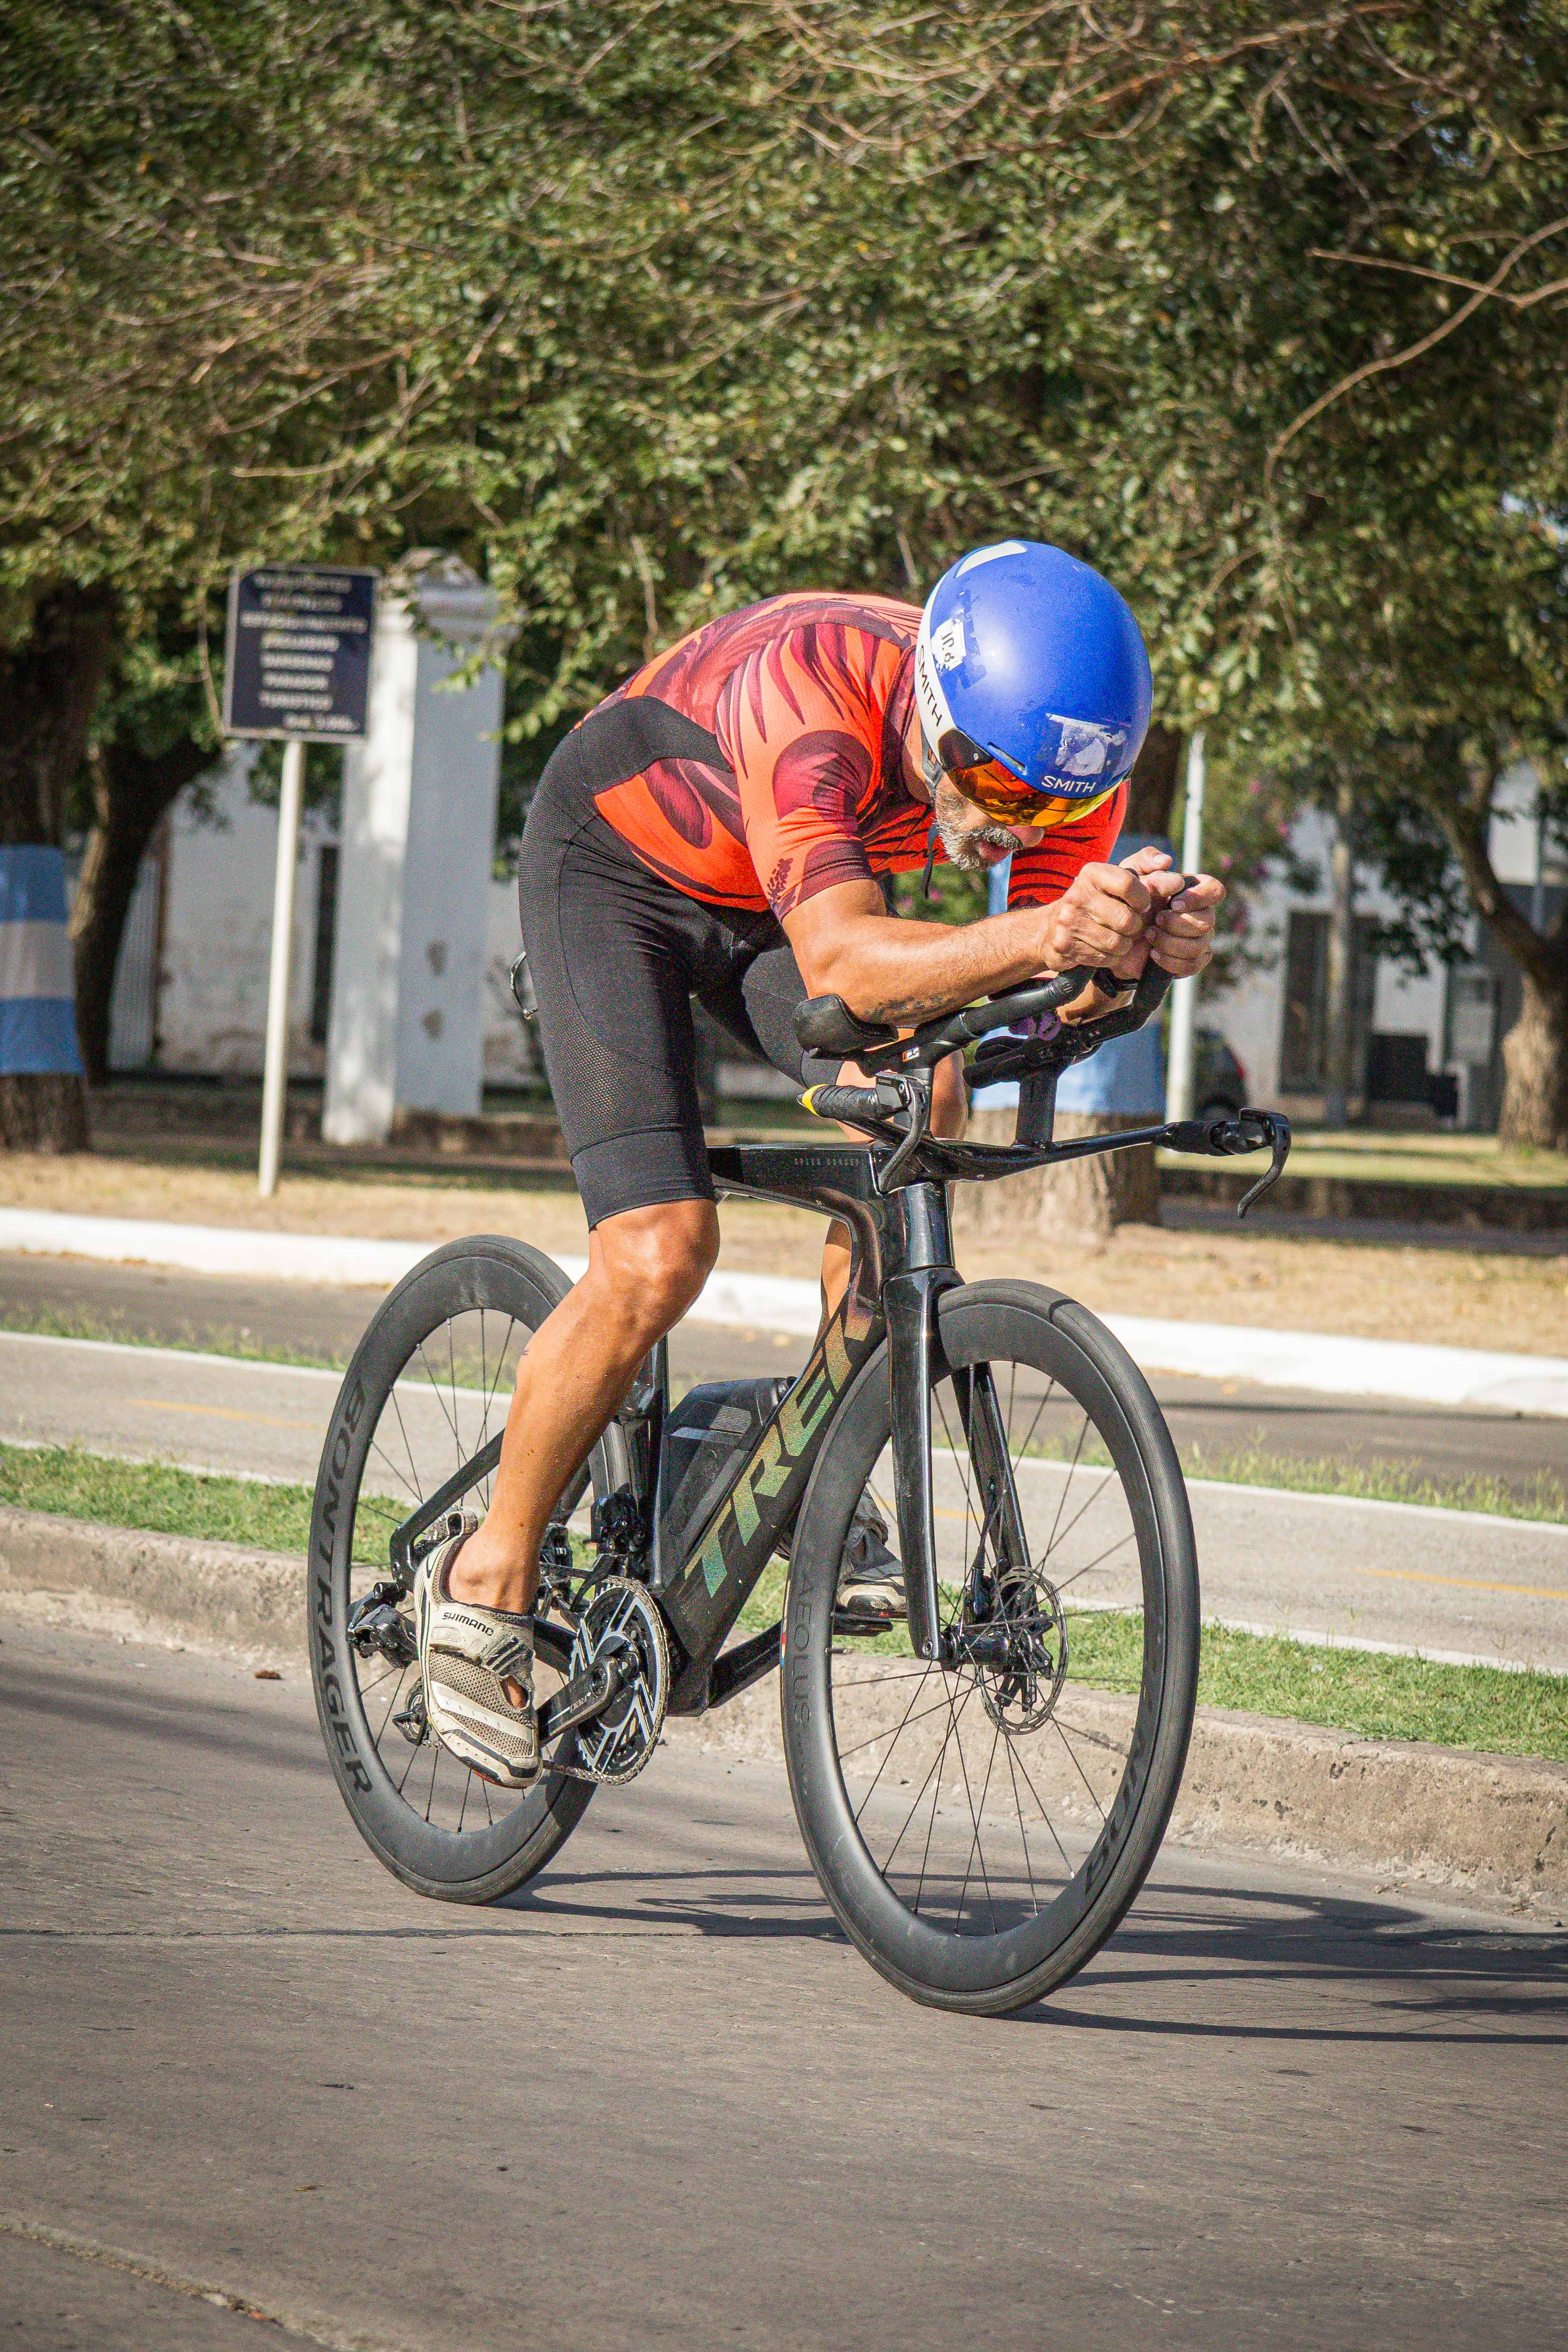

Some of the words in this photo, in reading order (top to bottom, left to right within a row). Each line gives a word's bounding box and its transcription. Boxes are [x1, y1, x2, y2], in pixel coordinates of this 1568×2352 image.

[918, 644, 942, 727] SMITH
[1042, 775, 1096, 793] SMITH
[684, 1258, 874, 1598] TREK
[317, 1380, 373, 1794] BONTRAGER
[442, 1612, 494, 1636] SHIMANO
[794, 1573, 814, 1725] AEOLUS
